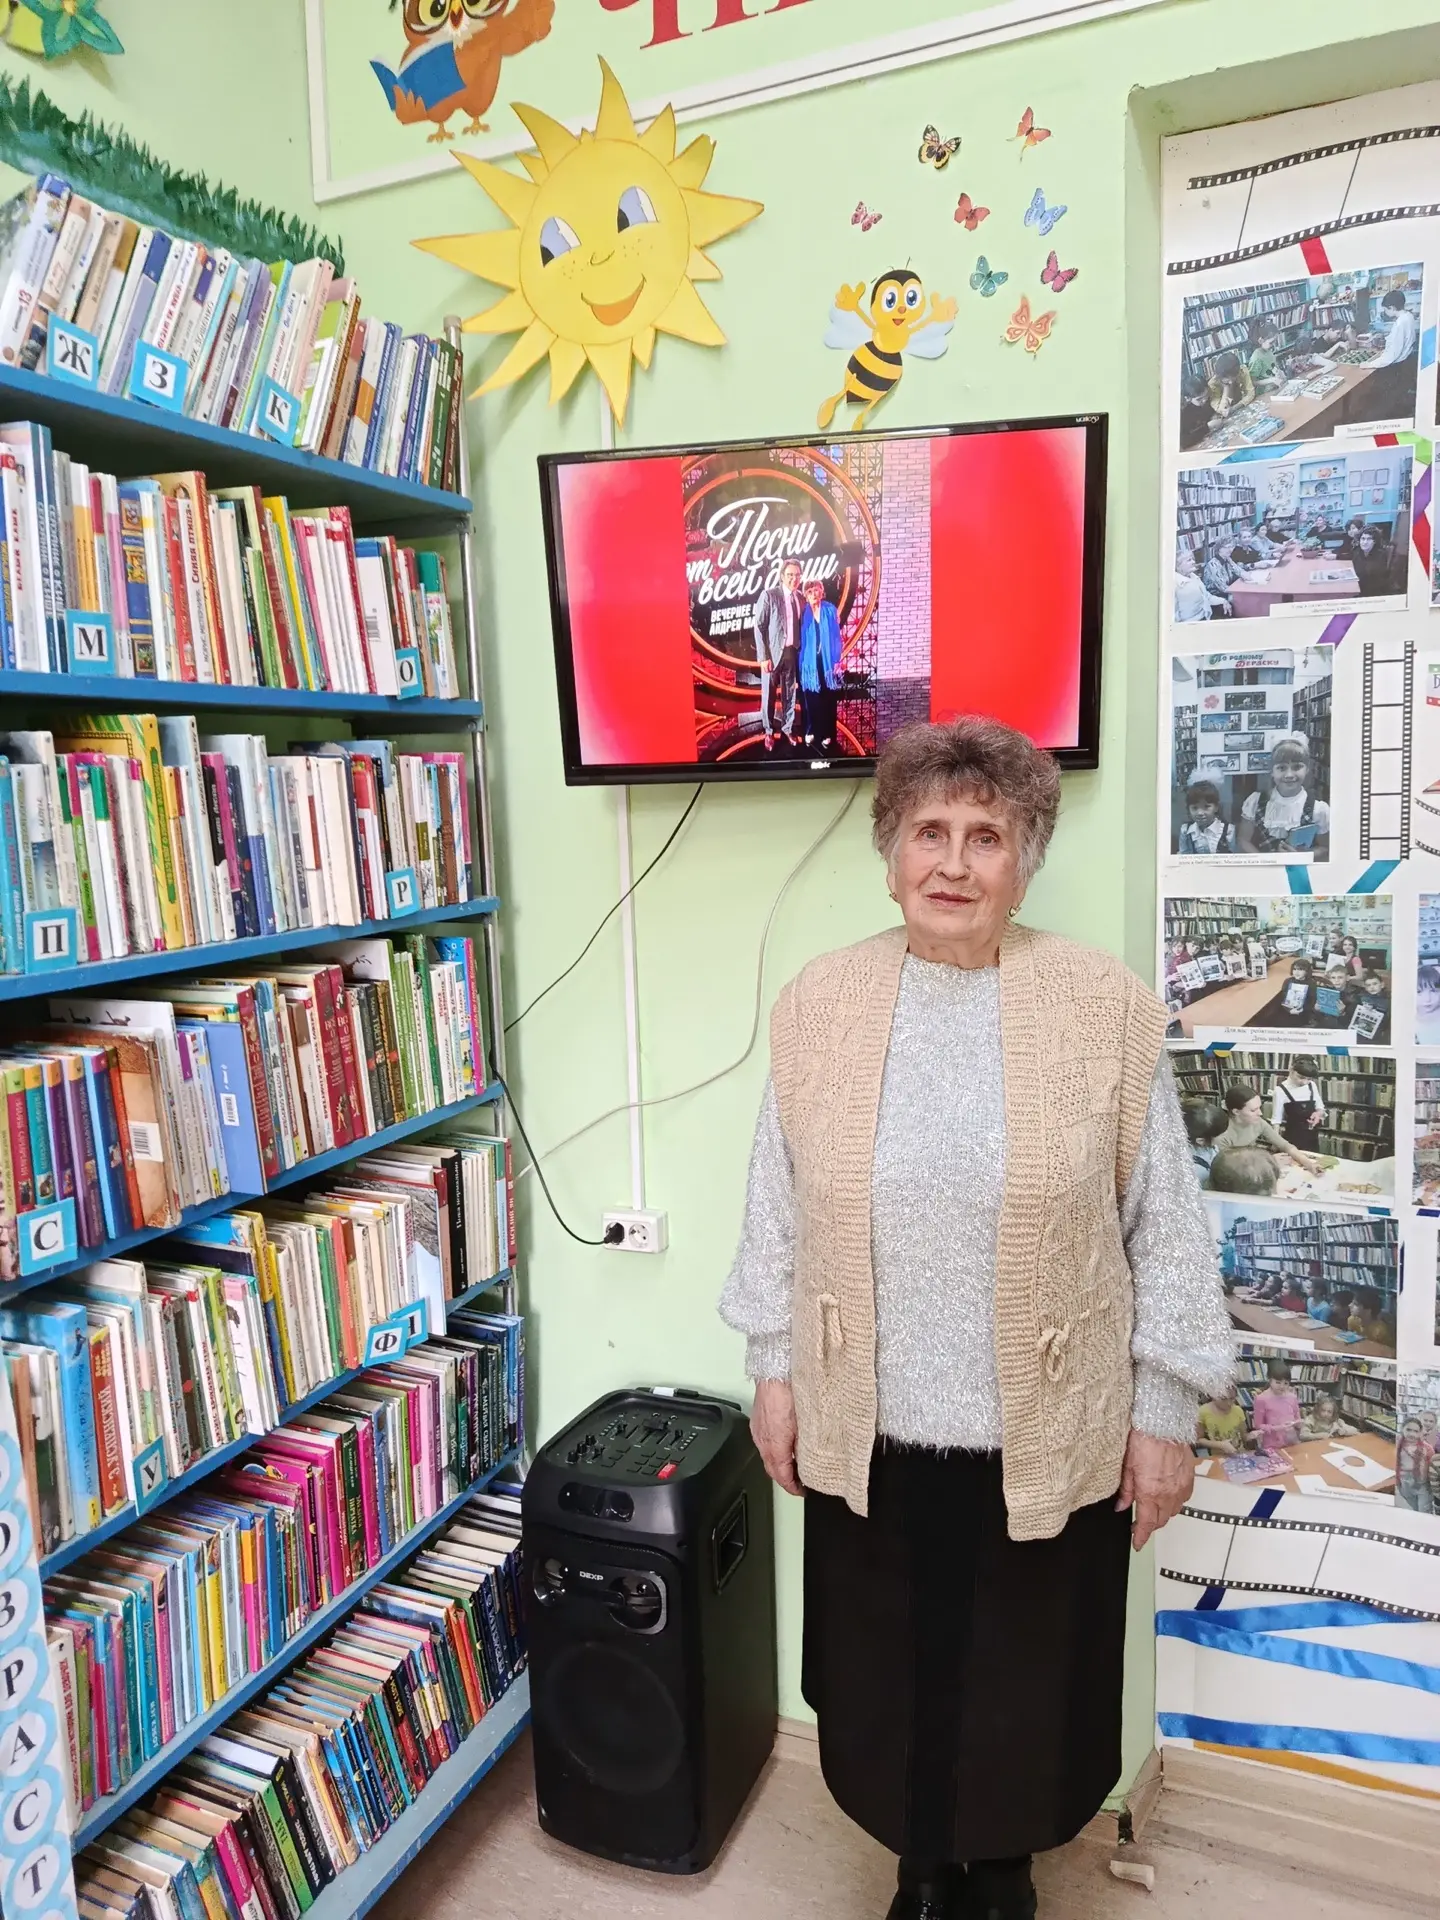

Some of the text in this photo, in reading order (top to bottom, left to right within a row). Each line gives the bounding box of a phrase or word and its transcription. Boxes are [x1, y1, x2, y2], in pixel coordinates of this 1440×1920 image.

[56, 337, 91, 375] Ж
[148, 360, 168, 387] З
[269, 395, 290, 427] К
[707, 497, 818, 568] Песни
[698, 553, 839, 605] всей дши
[709, 619, 741, 636] АНДРЕЯ
[711, 605, 752, 622] ВЕЧЕРНЕЕ
[78, 628, 107, 656] М
[400, 661, 413, 682] О
[396, 882, 409, 902] Р
[42, 926, 65, 954] П
[34, 1220, 59, 1251] С
[375, 1333, 397, 1352] Ф
[142, 1462, 161, 1490] У
[579, 1570, 604, 1581] DEXP
